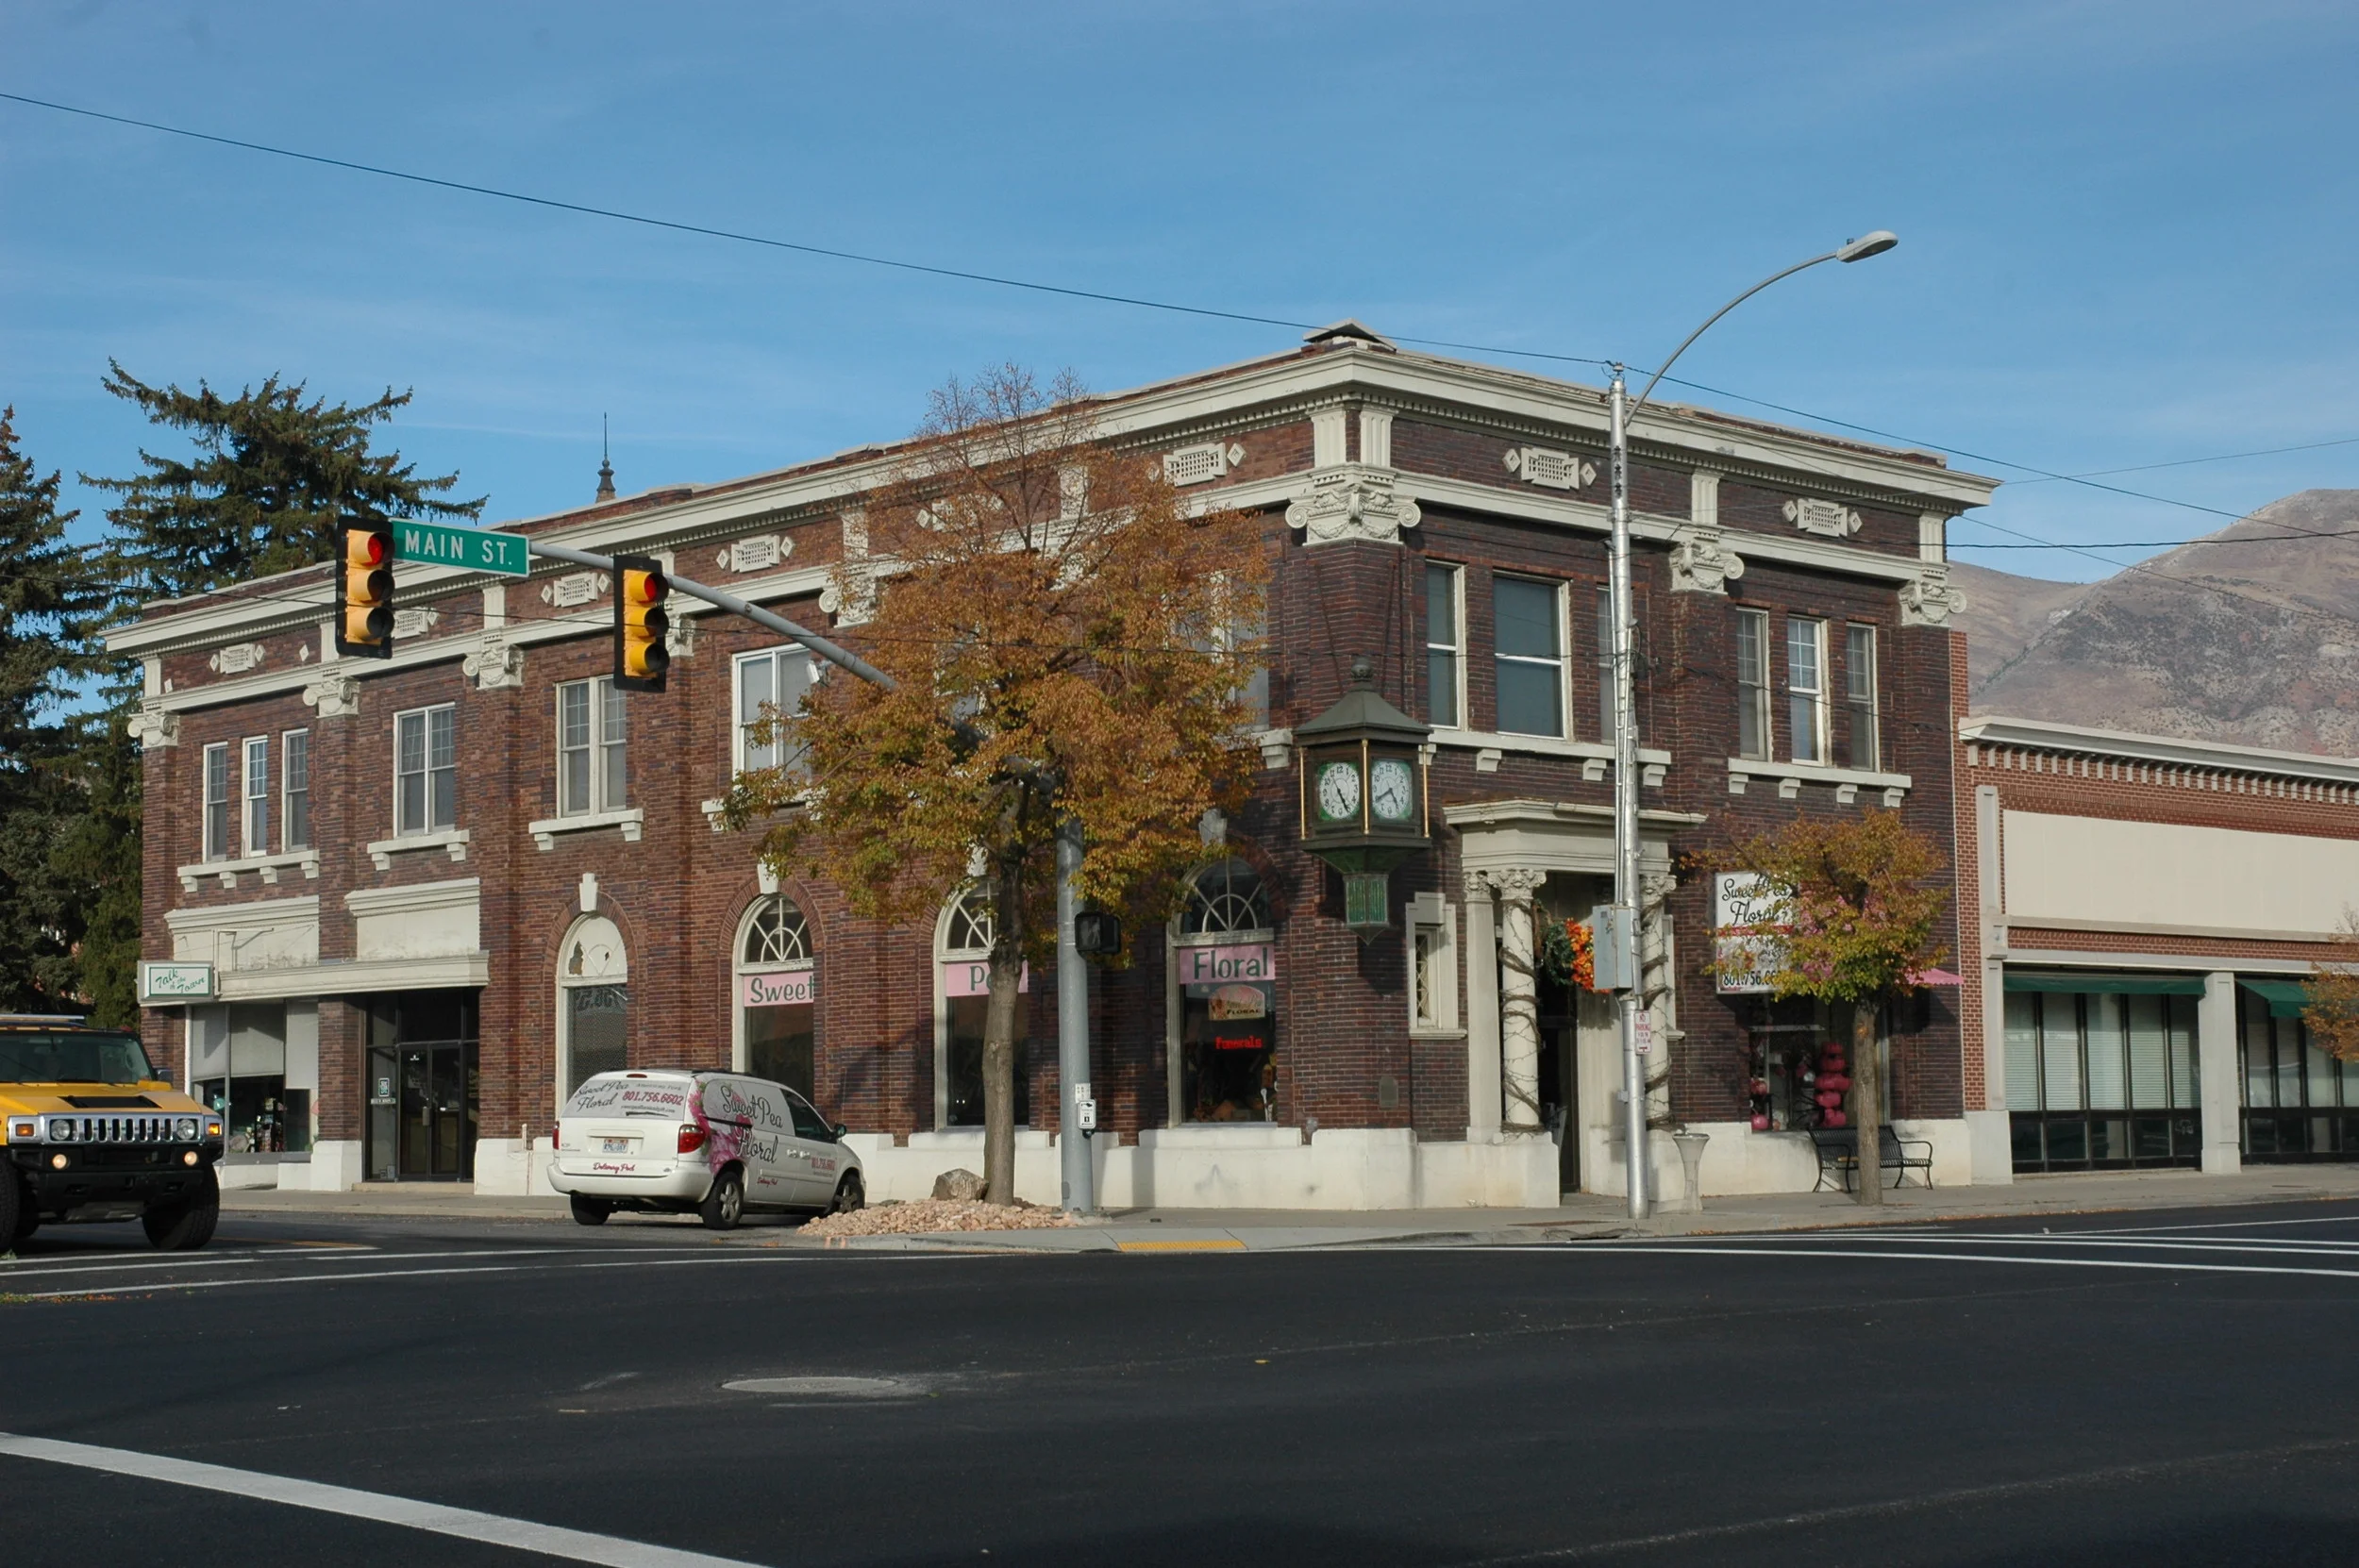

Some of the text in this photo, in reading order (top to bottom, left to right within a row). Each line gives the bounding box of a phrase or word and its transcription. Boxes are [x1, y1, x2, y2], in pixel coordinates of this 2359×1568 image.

[405, 530, 513, 566] MAIN ST.
[1194, 947, 1268, 979] Floral
[156, 968, 178, 988] Talk
[176, 977, 205, 993] Town
[750, 976, 814, 1003] Sweet
[1215, 1035, 1263, 1049] Funerals
[577, 1093, 618, 1112] Floral
[622, 1091, 684, 1106] 801.756.6602
[720, 1085, 783, 1128] Sweet Pea
[736, 1127, 778, 1163] Floral
